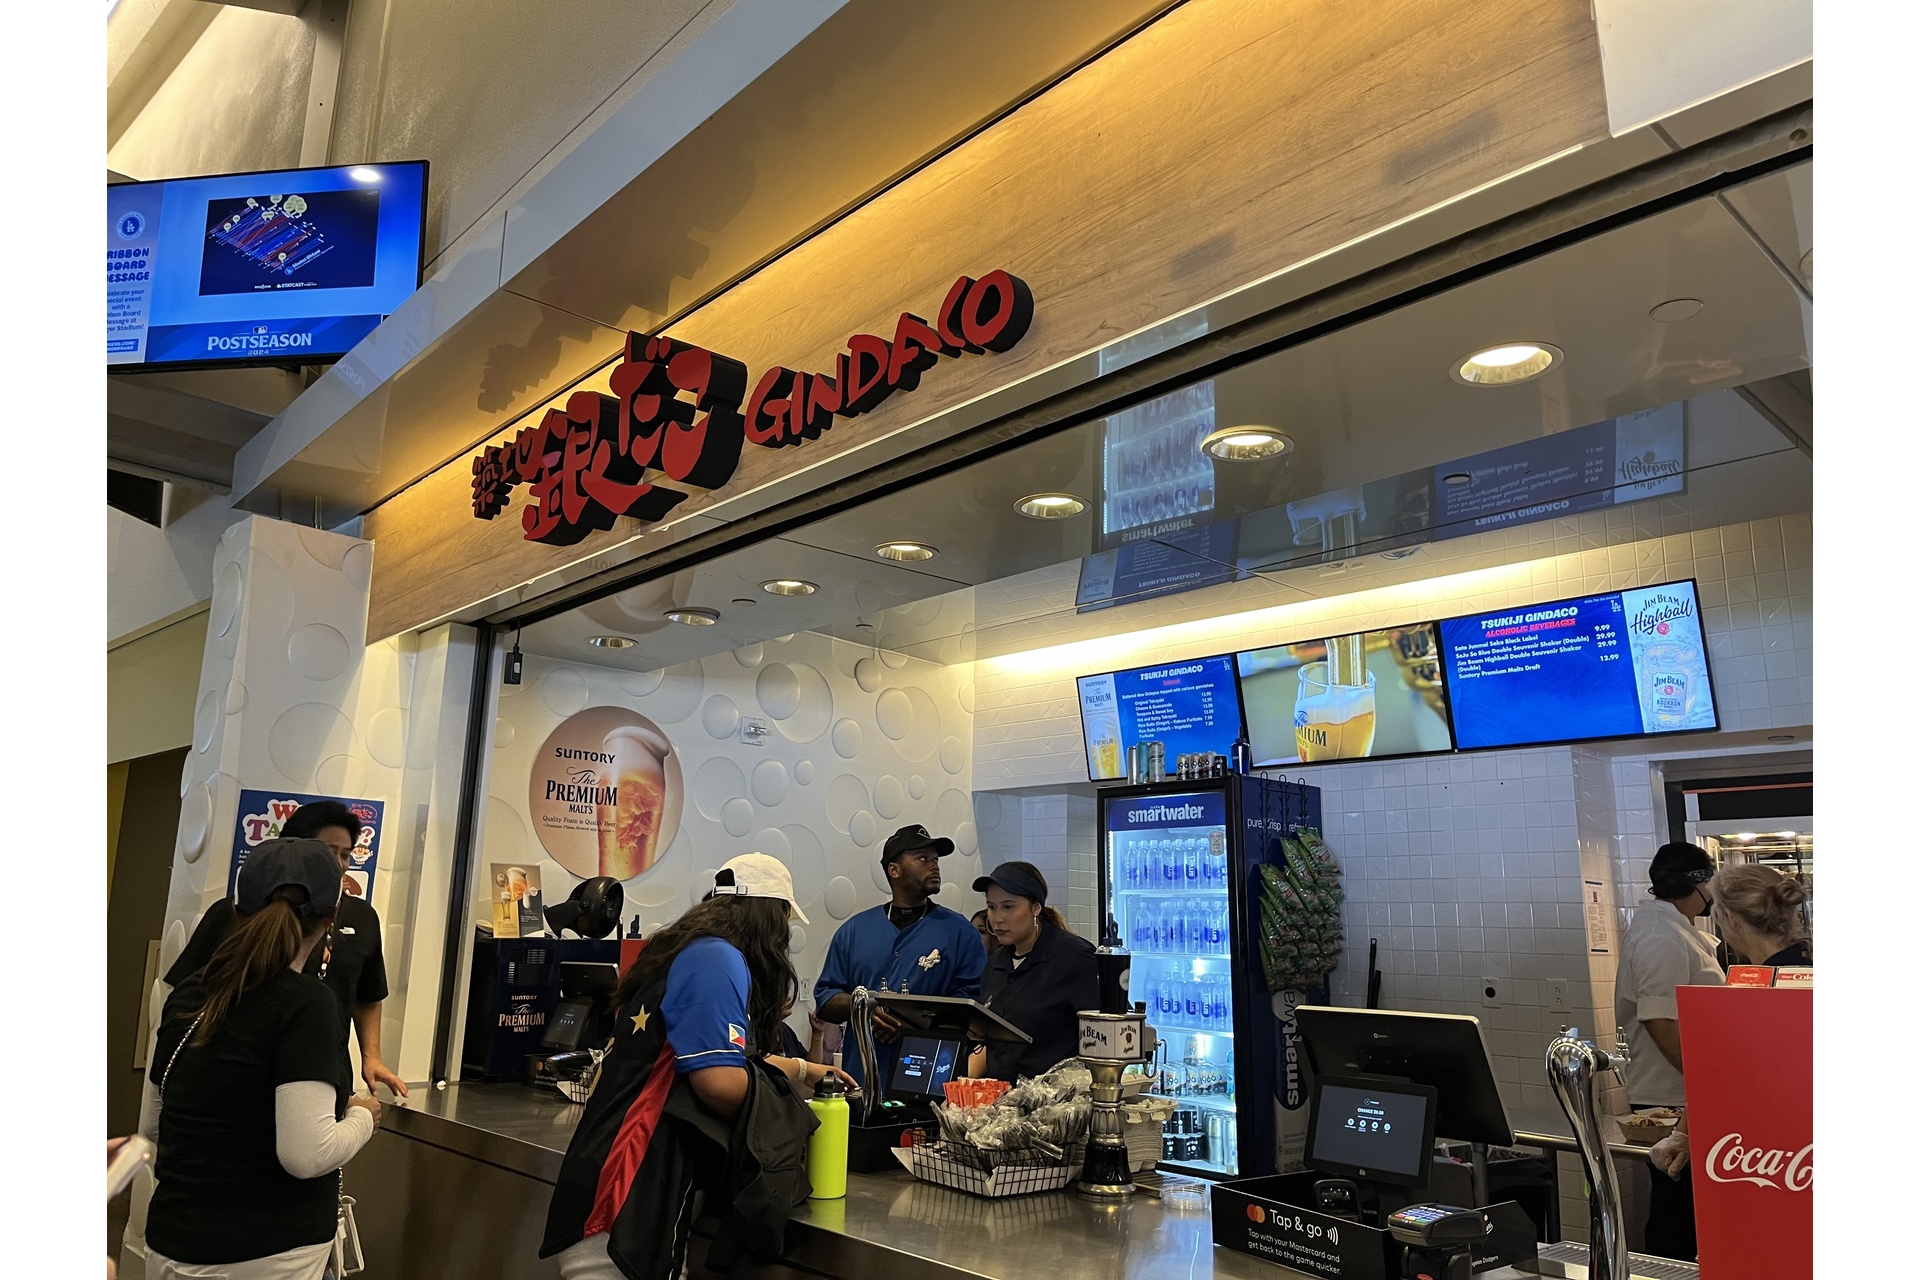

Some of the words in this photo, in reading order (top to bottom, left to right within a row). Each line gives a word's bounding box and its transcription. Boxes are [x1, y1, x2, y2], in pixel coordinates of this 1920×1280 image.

[107, 248, 149, 259] RIBBON
[107, 260, 147, 271] BOARD
[107, 272, 150, 282] ESSAGE
[207, 333, 312, 350] POSTSEASON
[744, 269, 1020, 447] GINDACO
[1643, 598, 1657, 611] JIM
[1657, 594, 1680, 607] BEAM
[1481, 615, 1523, 629] TSUKIJI
[1525, 606, 1578, 622] GINDACO
[1630, 598, 1693, 635] Highball
[1485, 625, 1528, 638] ALCOHOLIC
[1530, 618, 1576, 631] BEVERAGES
[1596, 632, 1616, 640] 29.99
[1492, 646, 1512, 654] Double
[1513, 642, 1539, 651] Souvenir
[1540, 640, 1562, 648] Shaker
[1505, 636, 1521, 644] Black
[1522, 634, 1538, 642] Label
[1597, 640, 1617, 648] 29.99
[1468, 657, 1484, 665] Beam
[1510, 652, 1530, 660] Double
[1532, 648, 1558, 657] Souvenir
[1559, 645, 1582, 653] Shaker
[1600, 653, 1619, 661] 12.99
[1140, 670, 1168, 681] TSUKIJI
[1169, 664, 1203, 677] GINDACO
[1459, 672, 1480, 680] Suntory
[1525, 663, 1540, 671] Draft
[1654, 676, 1667, 688] JIM
[1667, 675, 1685, 689] BEAM
[1085, 693, 1111, 704] PREMIUM
[1656, 699, 1681, 707] BOURBON
[555, 747, 616, 764] SUNTORY
[566, 766, 601, 786] The
[545, 779, 618, 806] PREMIUM
[568, 803, 594, 814] MALT'S
[1128, 803, 1204, 823] smartwater
[542, 815, 562, 823] Quality
[563, 816, 578, 824] Foam
[498, 1012, 545, 1027] PREMIUM
[1086, 1026, 1108, 1047] BEAM
[1282, 991, 1300, 1106] smartwa
[1705, 1133, 1813, 1192] Coca-C
[1269, 1208, 1292, 1231] Tap
[1294, 1216, 1304, 1232] &
[1306, 1223, 1323, 1239] go
[1248, 1228, 1260, 1239] Tap
[1260, 1232, 1274, 1243] with
[1274, 1237, 1288, 1247] your
[1289, 1240, 1326, 1259] Mastercard
[1326, 1252, 1340, 1263] and
[1248, 1241, 1259, 1250] get
[1259, 1242, 1275, 1254] back
[1275, 1248, 1283, 1257] to
[1284, 1250, 1295, 1260] the
[1295, 1255, 1315, 1267] game
[1316, 1260, 1342, 1275] quicker.
